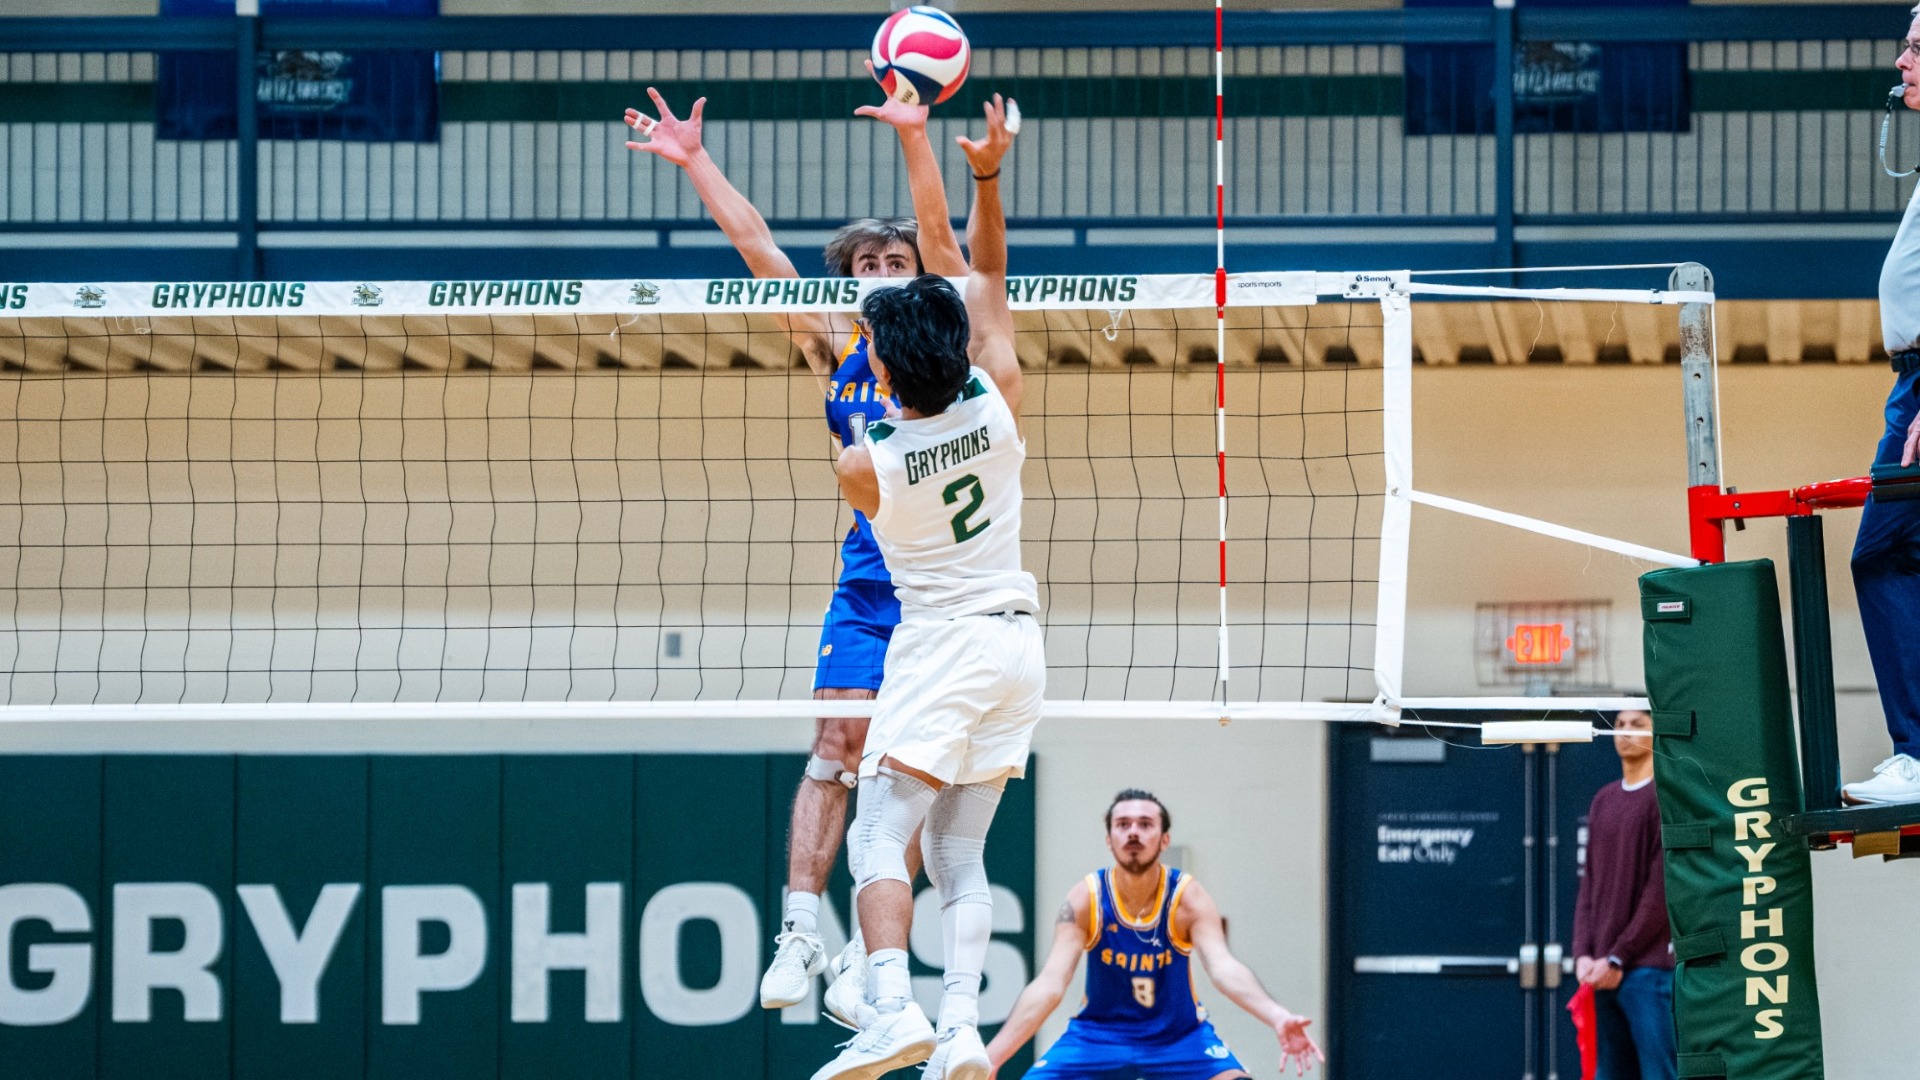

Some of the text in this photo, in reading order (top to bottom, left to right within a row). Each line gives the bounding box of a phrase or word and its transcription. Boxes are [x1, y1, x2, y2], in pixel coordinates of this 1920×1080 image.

[152, 283, 305, 308] GRYPHONS
[429, 280, 583, 306] GRYPHONS
[706, 278, 860, 305] GRYPHONS
[1006, 277, 1138, 303] RYPHONS
[826, 380, 891, 403] SAIN
[904, 424, 991, 486] GRYPHONS
[941, 473, 991, 544] 2
[1377, 824, 1475, 848] Emergency
[1726, 777, 1789, 1040] GRYPHONS
